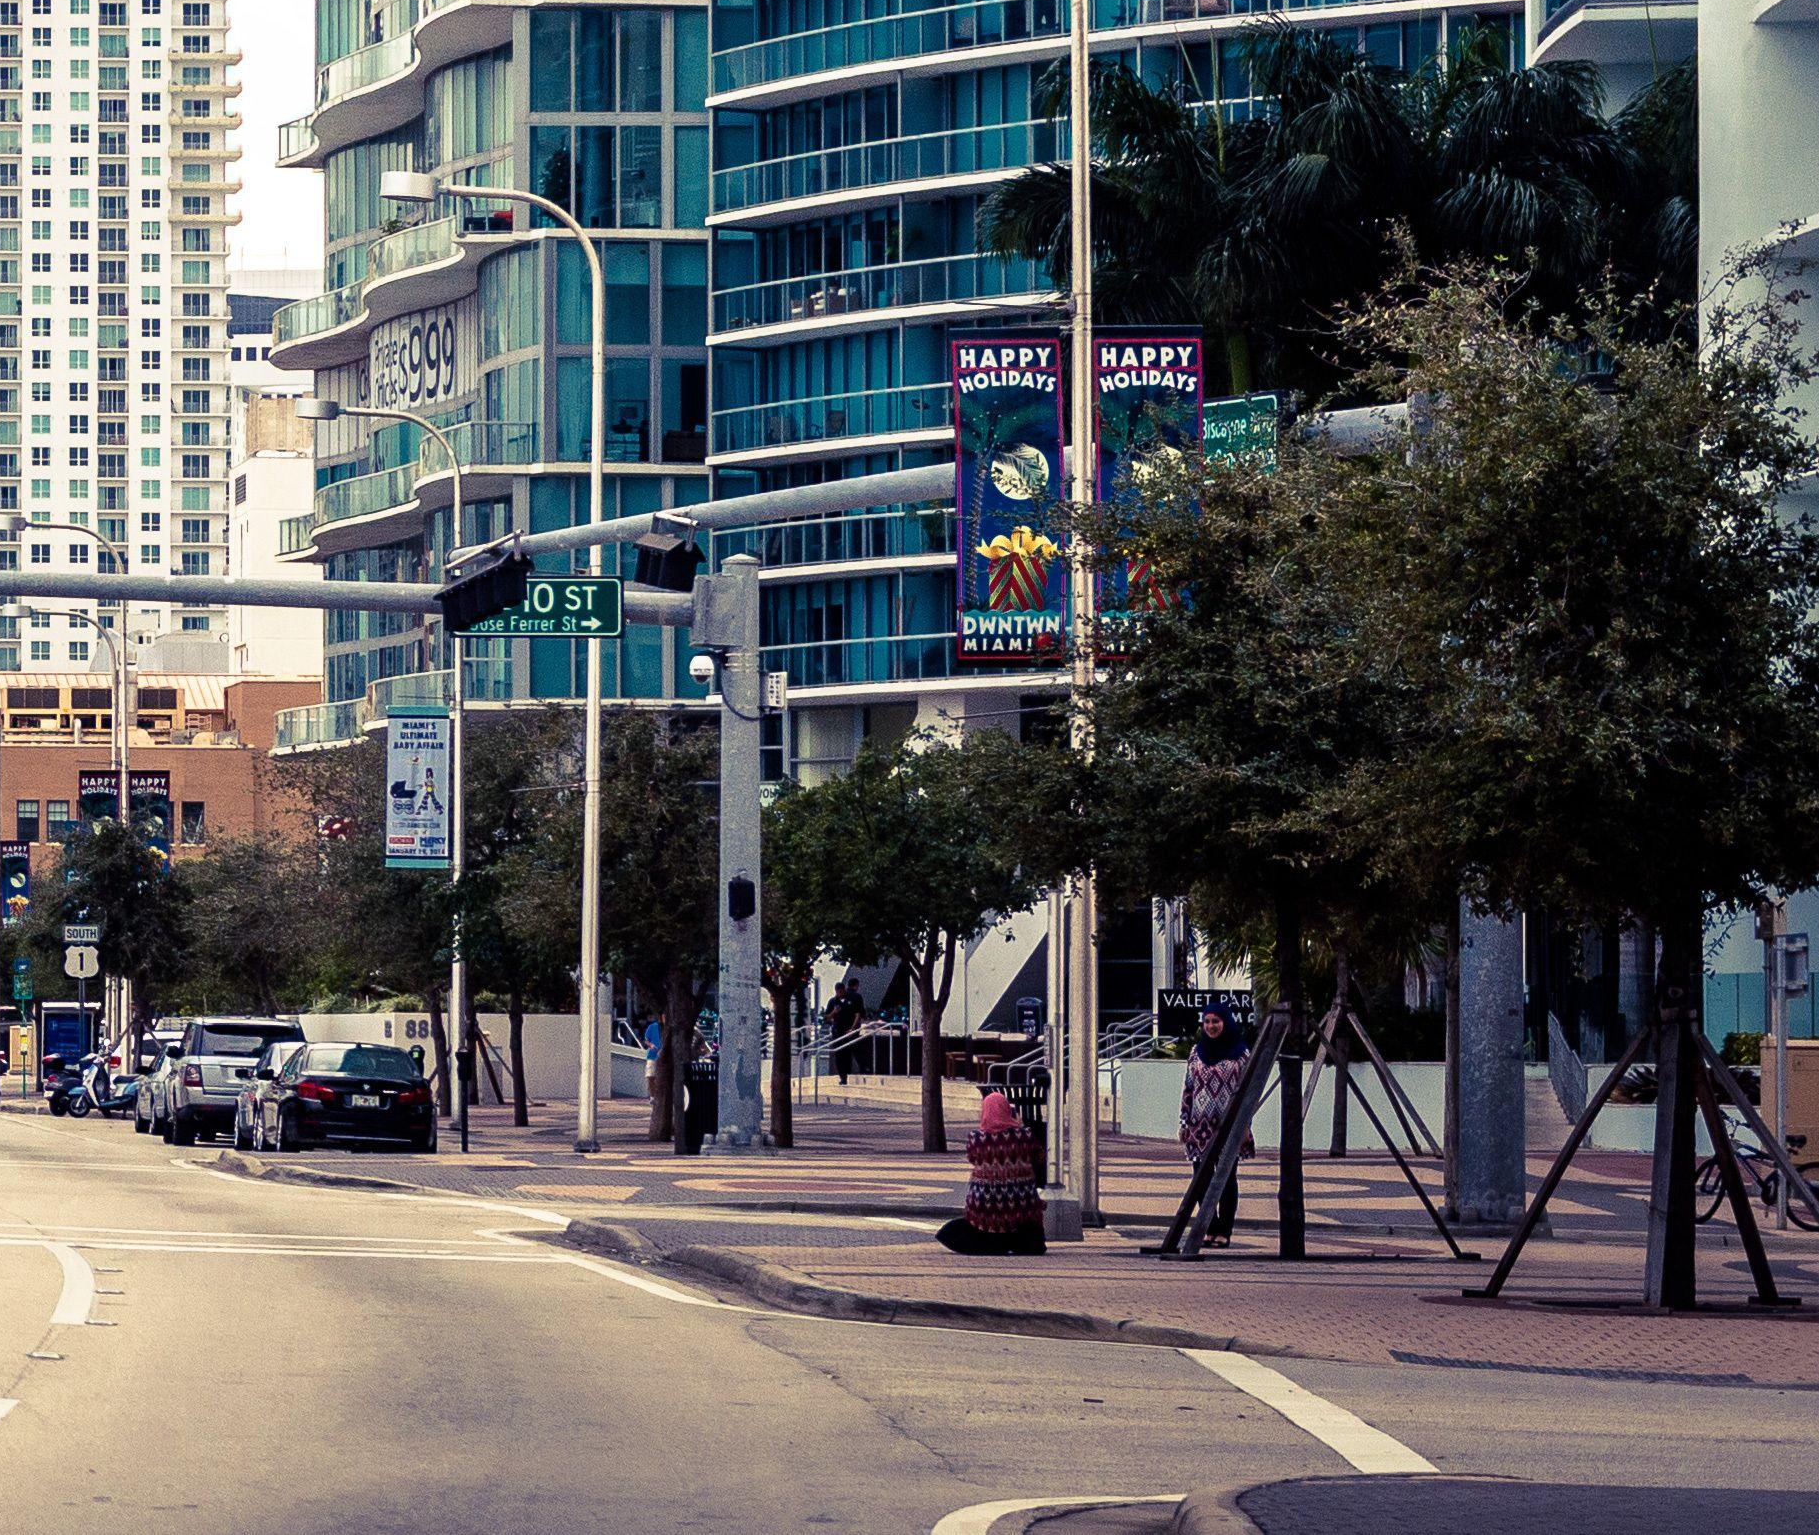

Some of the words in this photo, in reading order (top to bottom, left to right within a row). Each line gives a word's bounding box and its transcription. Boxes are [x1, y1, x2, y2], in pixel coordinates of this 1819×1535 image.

[399, 317, 455, 403] $999
[959, 347, 1052, 369] HAPPY
[1101, 346, 1193, 368] HAPPY
[958, 370, 1057, 394] HOLIDAYS
[1099, 369, 1198, 393] HOLIDAYS
[565, 585, 598, 611] ST
[510, 615, 556, 631] Ferrer
[562, 615, 577, 632] St
[962, 615, 1060, 635] DWNTWN
[399, 731, 438, 740] ULTIMATE
[393, 741, 415, 750] BABY
[417, 741, 444, 750] AFFAIR
[81, 777, 117, 786] HAPPY
[131, 777, 166, 786] HAPPY
[81, 787, 118, 796] HOLIDAYS
[130, 787, 168, 796] HOLIDAYS
[66, 928, 97, 939] SOUTH
[1163, 993, 1212, 1008] VALET
